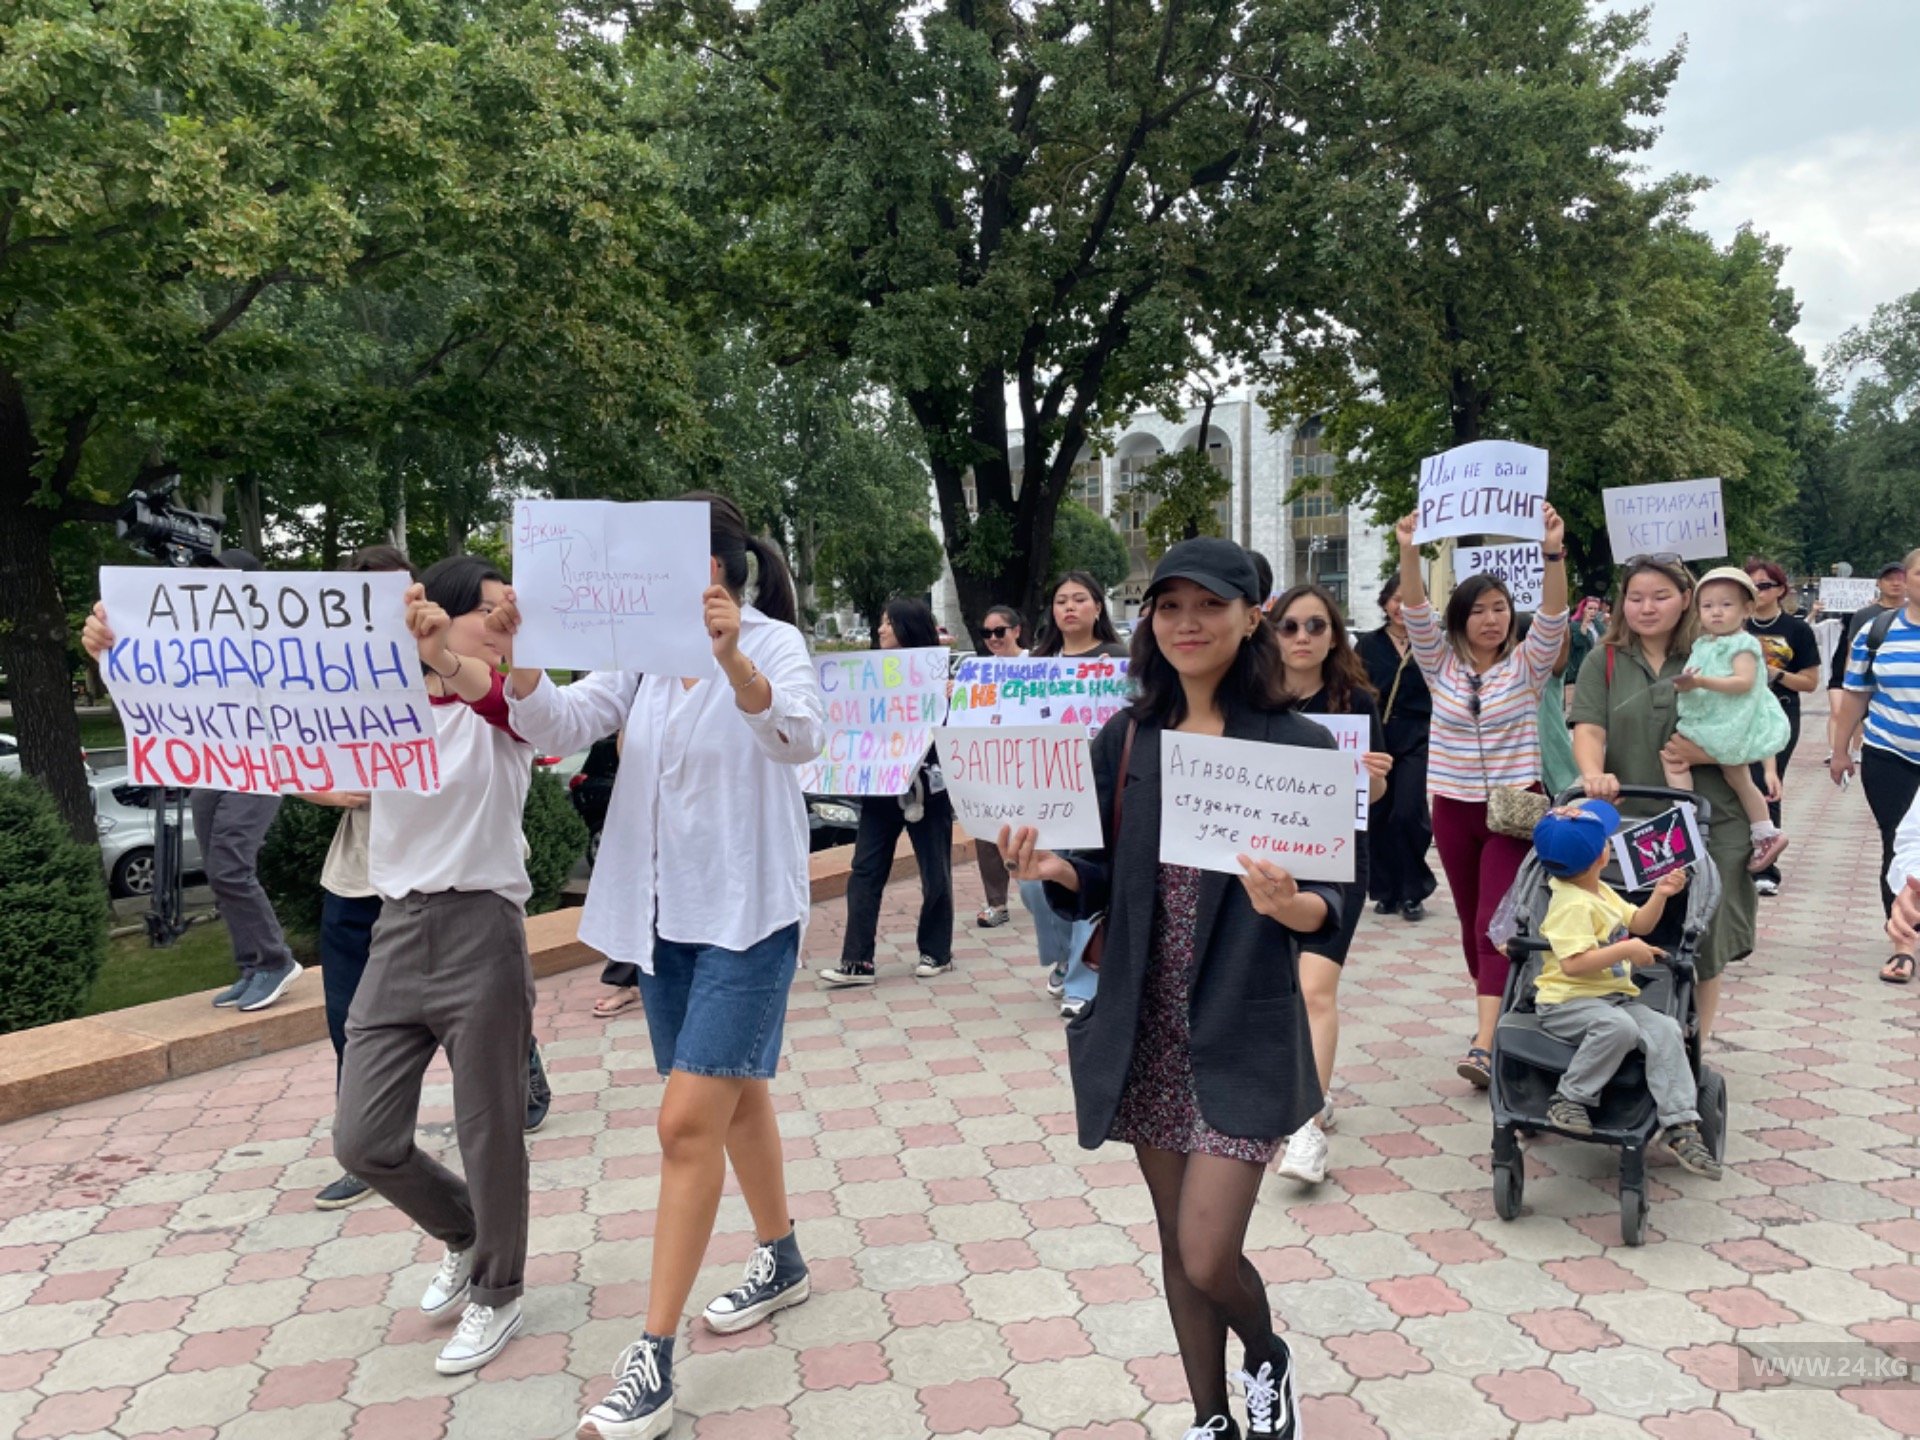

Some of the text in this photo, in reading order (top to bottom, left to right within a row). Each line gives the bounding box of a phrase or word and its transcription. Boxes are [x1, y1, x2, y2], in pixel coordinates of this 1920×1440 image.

[1420, 454, 1456, 492] Мы
[1422, 487, 1544, 528] РЕЙТИНГ
[1615, 491, 1720, 515] ПАТРИАРХАТ
[1470, 546, 1538, 569] ЭРКИН
[148, 583, 374, 632] АТАЗОВ!
[552, 585, 649, 613] ЭРКИН
[107, 636, 409, 693] КЫЗДАРДЫН
[957, 661, 1062, 684] ЖЕНЩИНА
[1076, 662, 1115, 680] ЭТО
[951, 686, 967, 711] А
[970, 683, 997, 709] НЕ
[121, 699, 423, 745] УКУКТАРЫНАН
[337, 736, 442, 791] ТАРТ!
[950, 736, 1085, 793] ЗАПРЕТИТЕ
